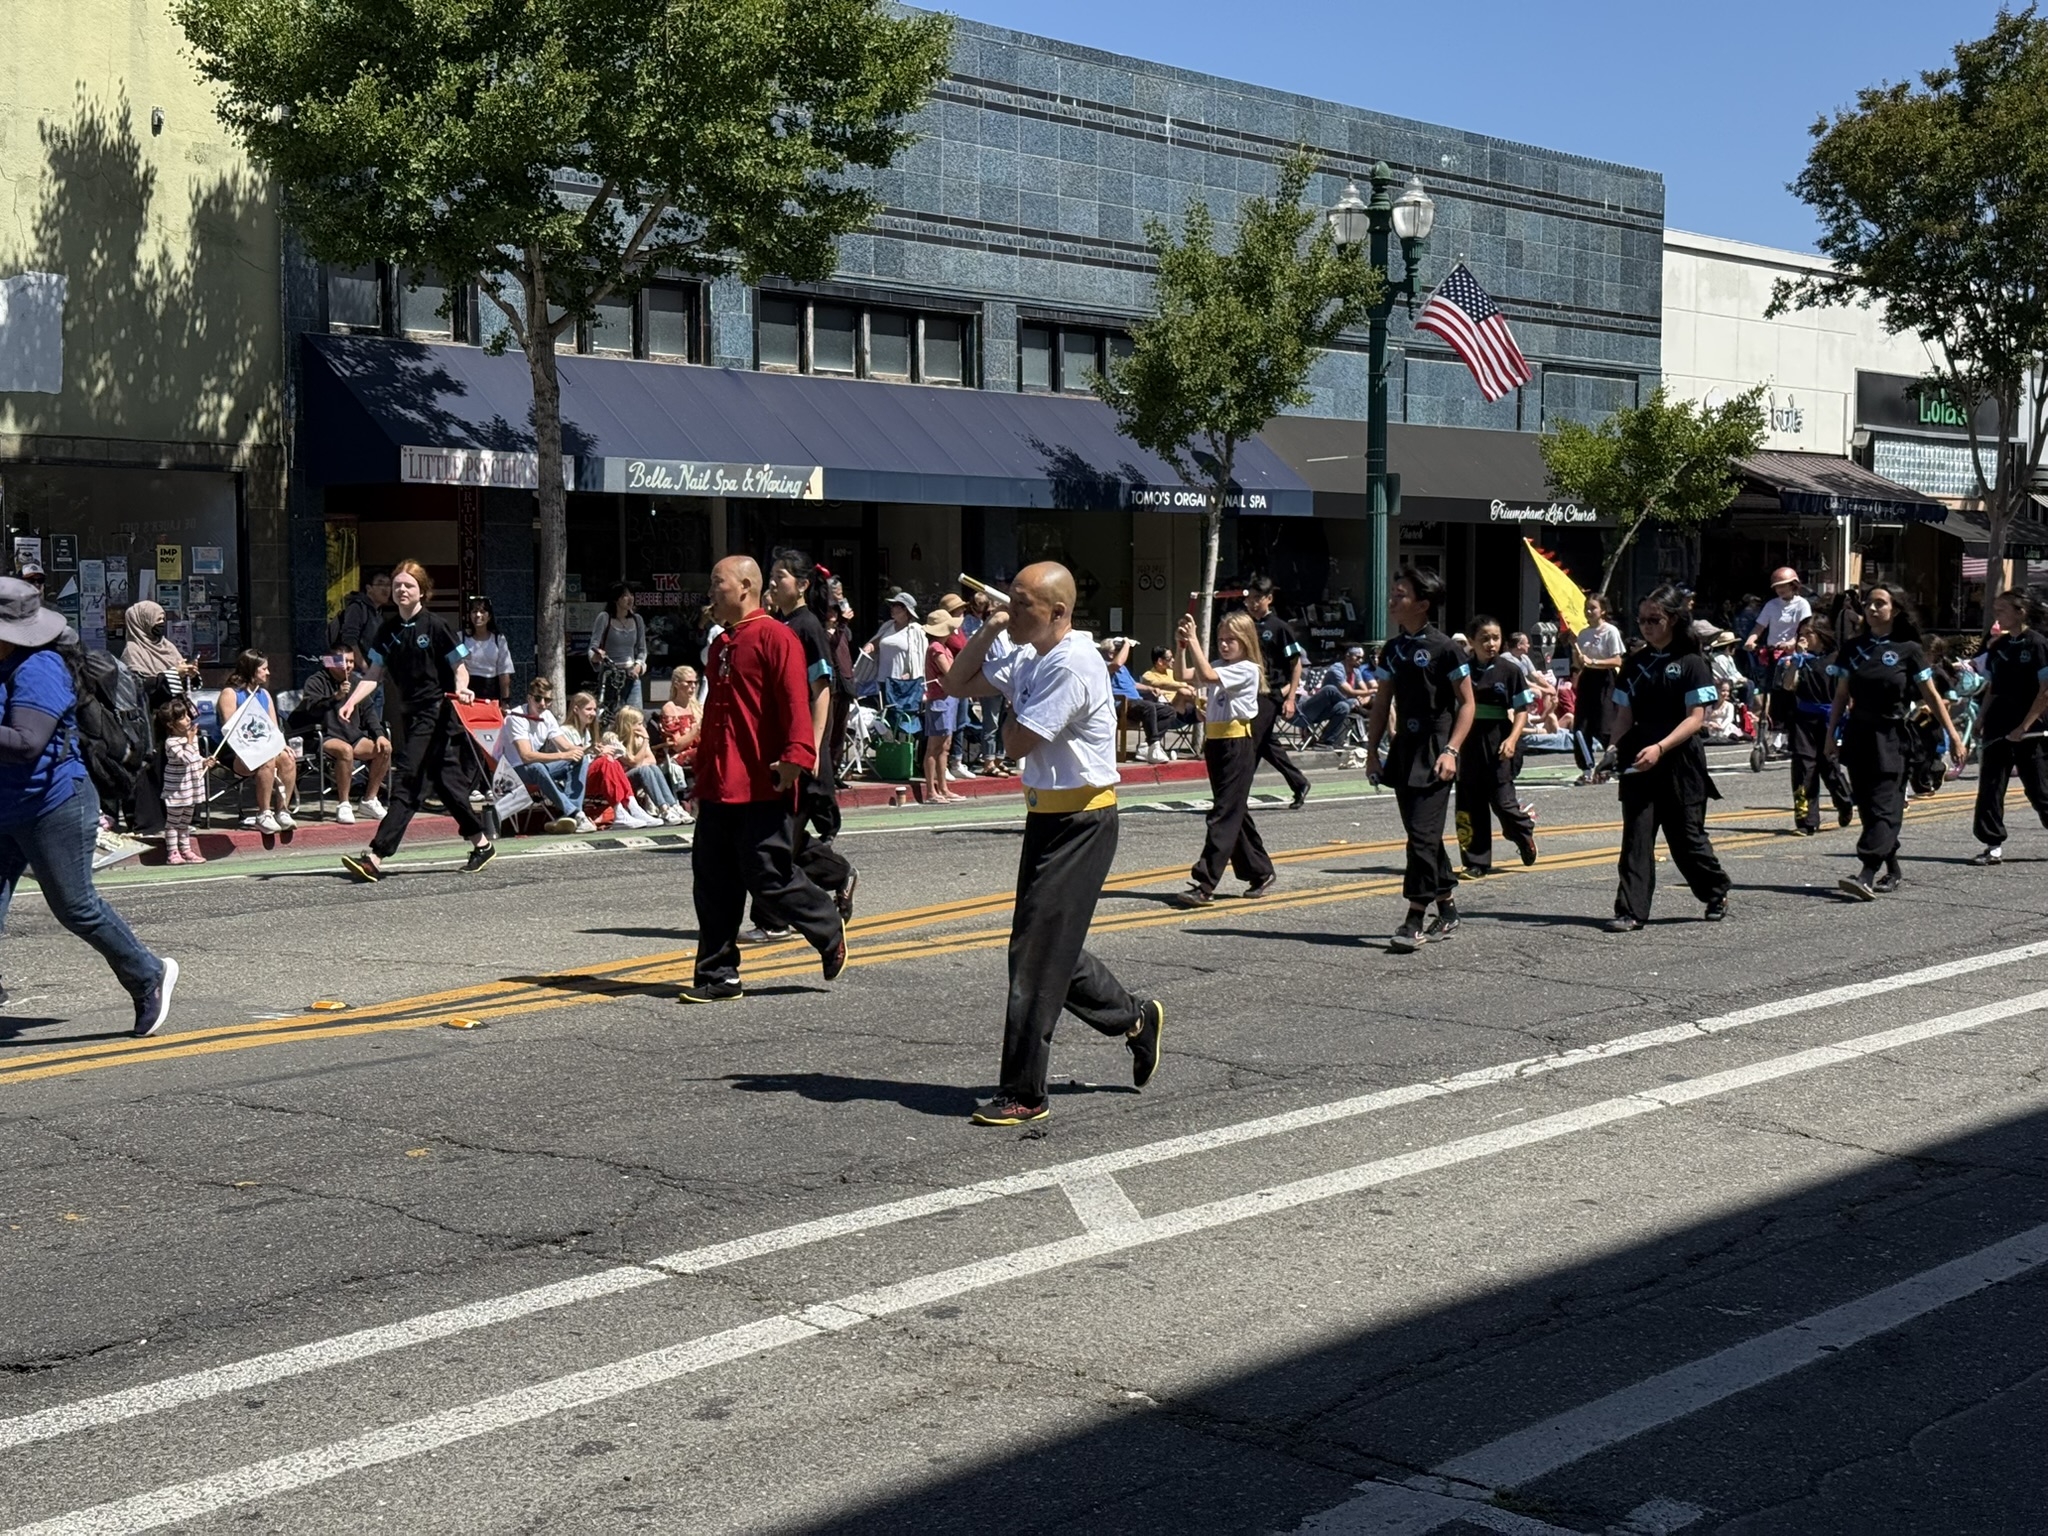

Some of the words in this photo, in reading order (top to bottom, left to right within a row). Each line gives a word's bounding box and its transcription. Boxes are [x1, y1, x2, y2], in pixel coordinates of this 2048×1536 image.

[408, 454, 462, 482] LITTLE
[628, 462, 673, 489] Bella
[674, 464, 711, 491] Nail
[712, 469, 738, 495] Spa
[742, 467, 755, 492] &
[756, 468, 803, 499] Waxing
[1131, 490, 1170, 506] TOMO'S
[1174, 491, 1217, 507] ORGA
[1225, 494, 1246, 508] NAIL
[1249, 494, 1267, 509] SPA
[463, 485, 475, 548] RTUNE
[1490, 499, 1545, 524] Triumphant
[1545, 502, 1563, 526] Life
[1564, 503, 1597, 523] Church
[160, 548, 178, 556] IMP
[652, 573, 682, 591] TK
[635, 592, 663, 606] BARBER
[664, 592, 683, 606] SHOP
[1310, 627, 1345, 638] Wednesday
